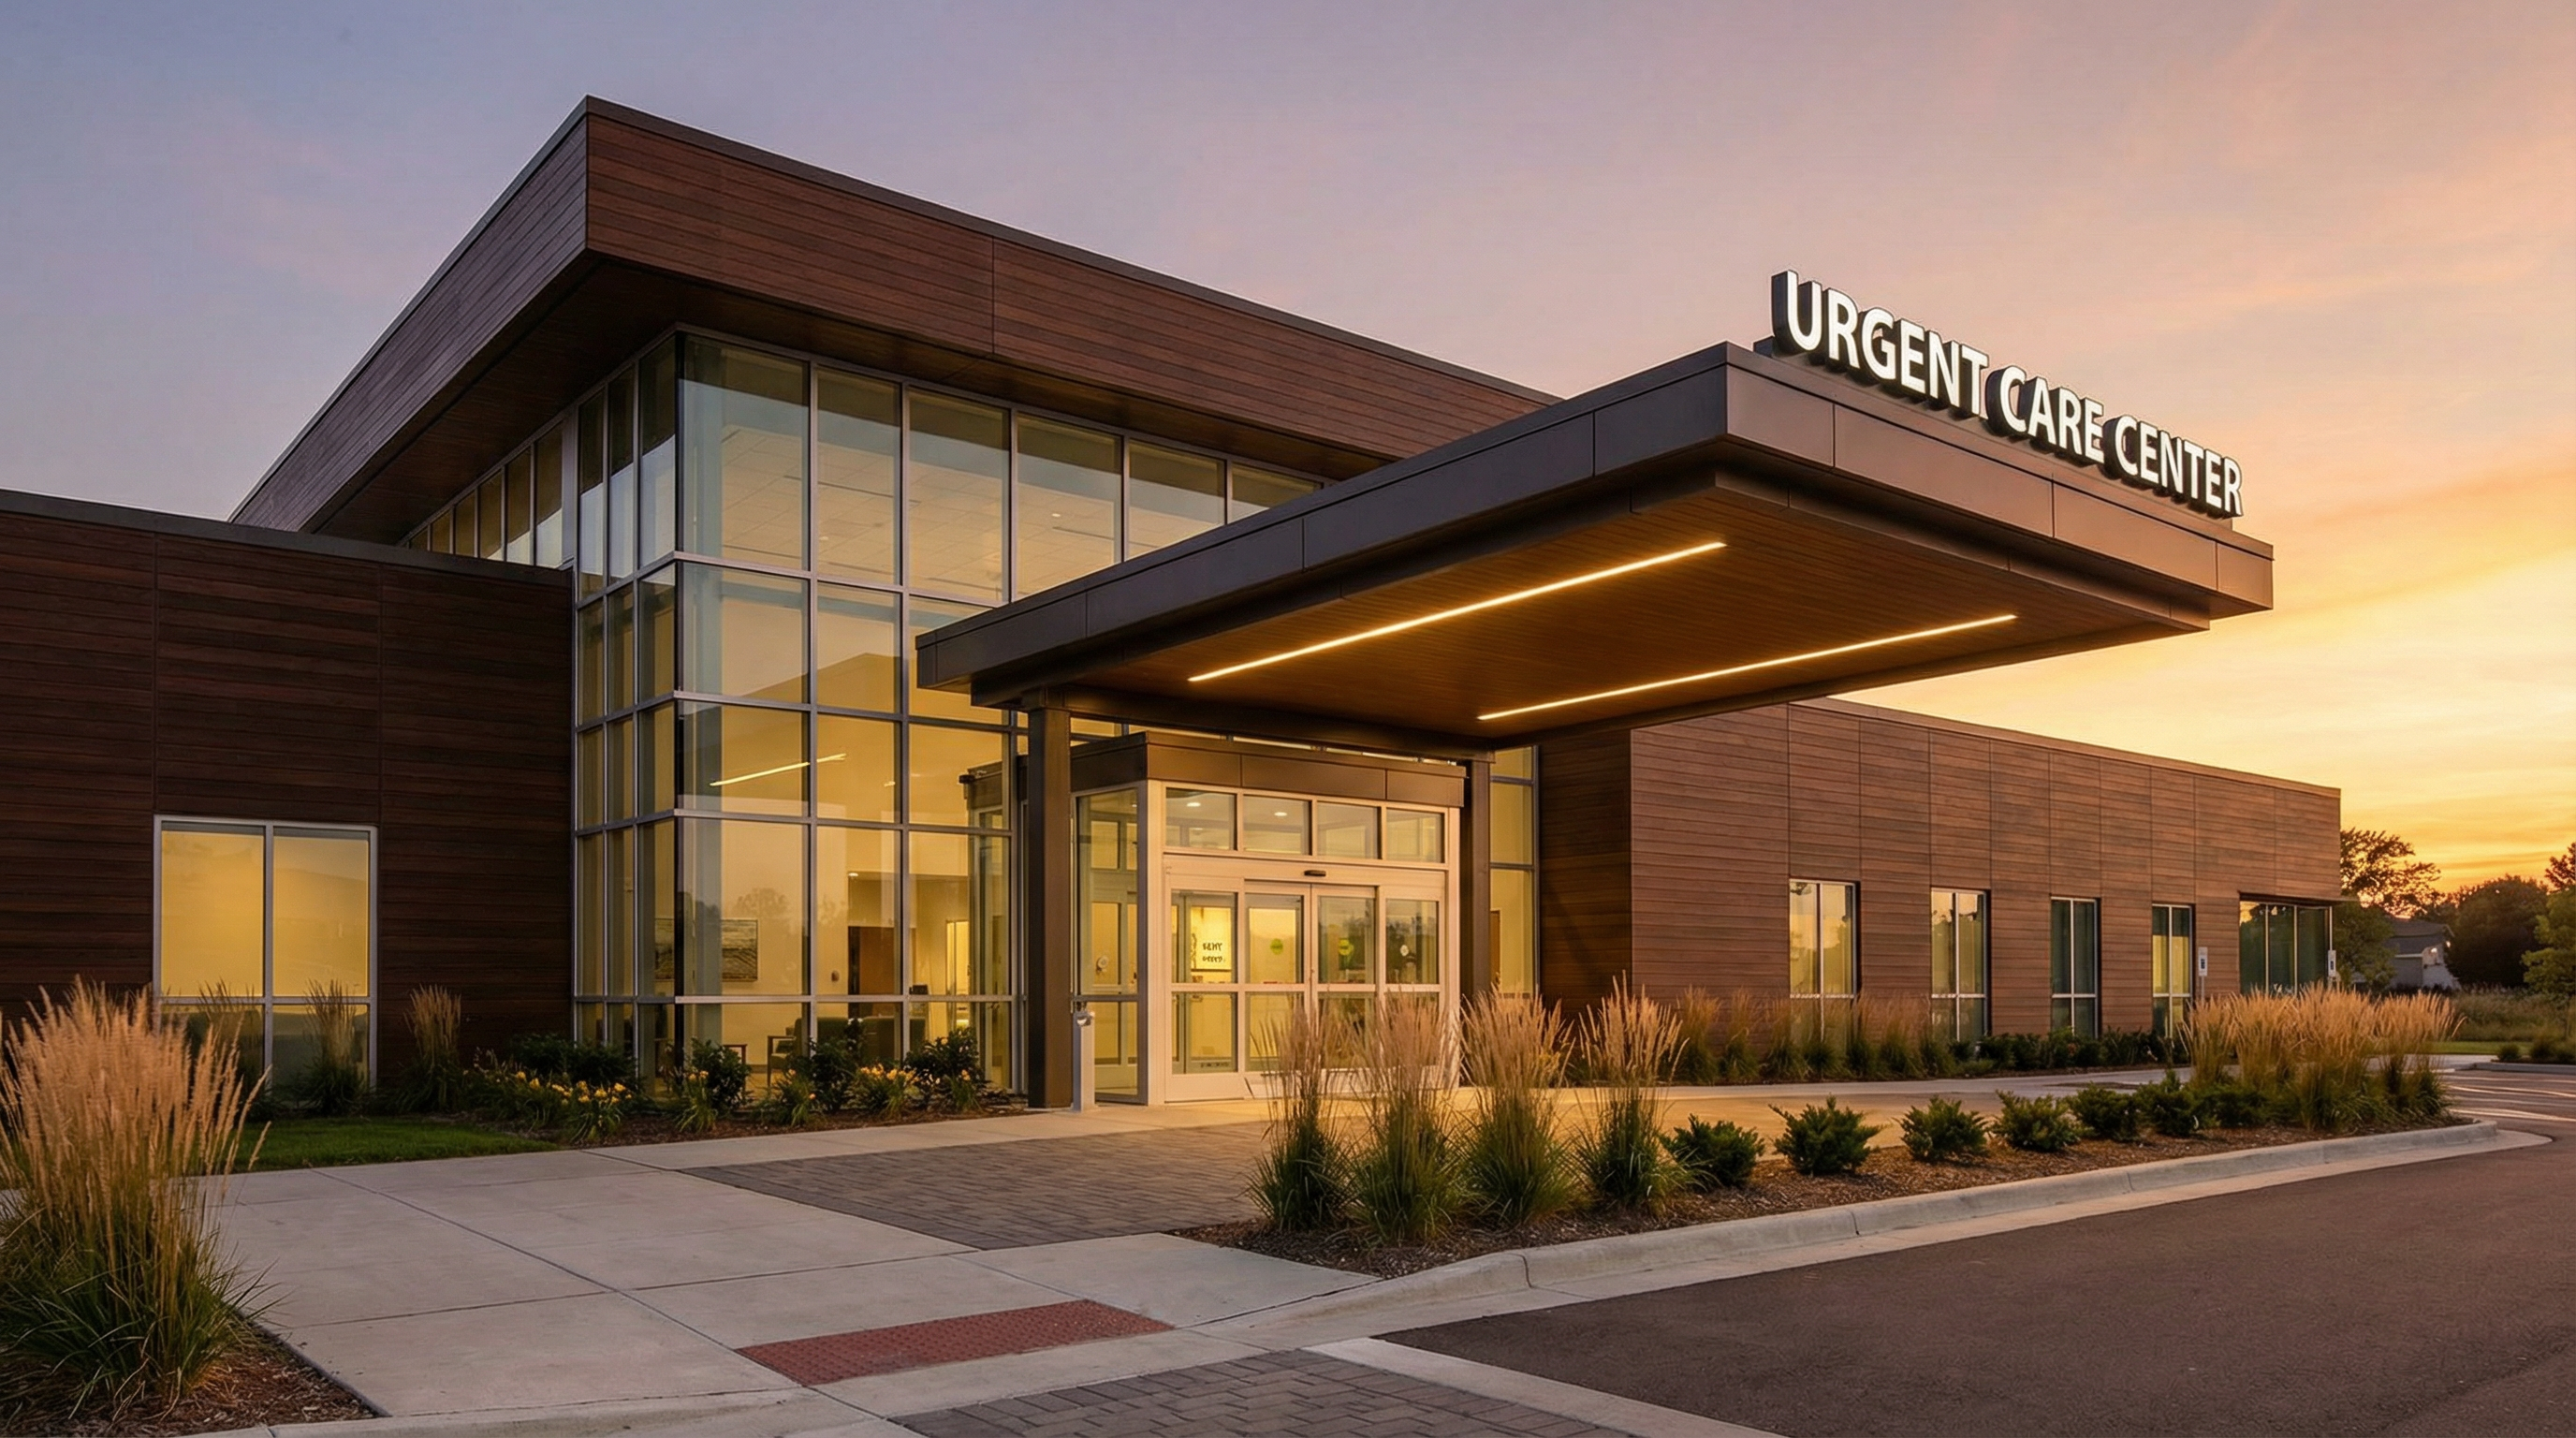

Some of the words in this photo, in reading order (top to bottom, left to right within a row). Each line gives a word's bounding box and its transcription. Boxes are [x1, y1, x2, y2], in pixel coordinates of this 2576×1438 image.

[1781, 269, 1989, 416] URGENT
[1997, 366, 2105, 463] CARE
[2114, 415, 2244, 516] CENTER
